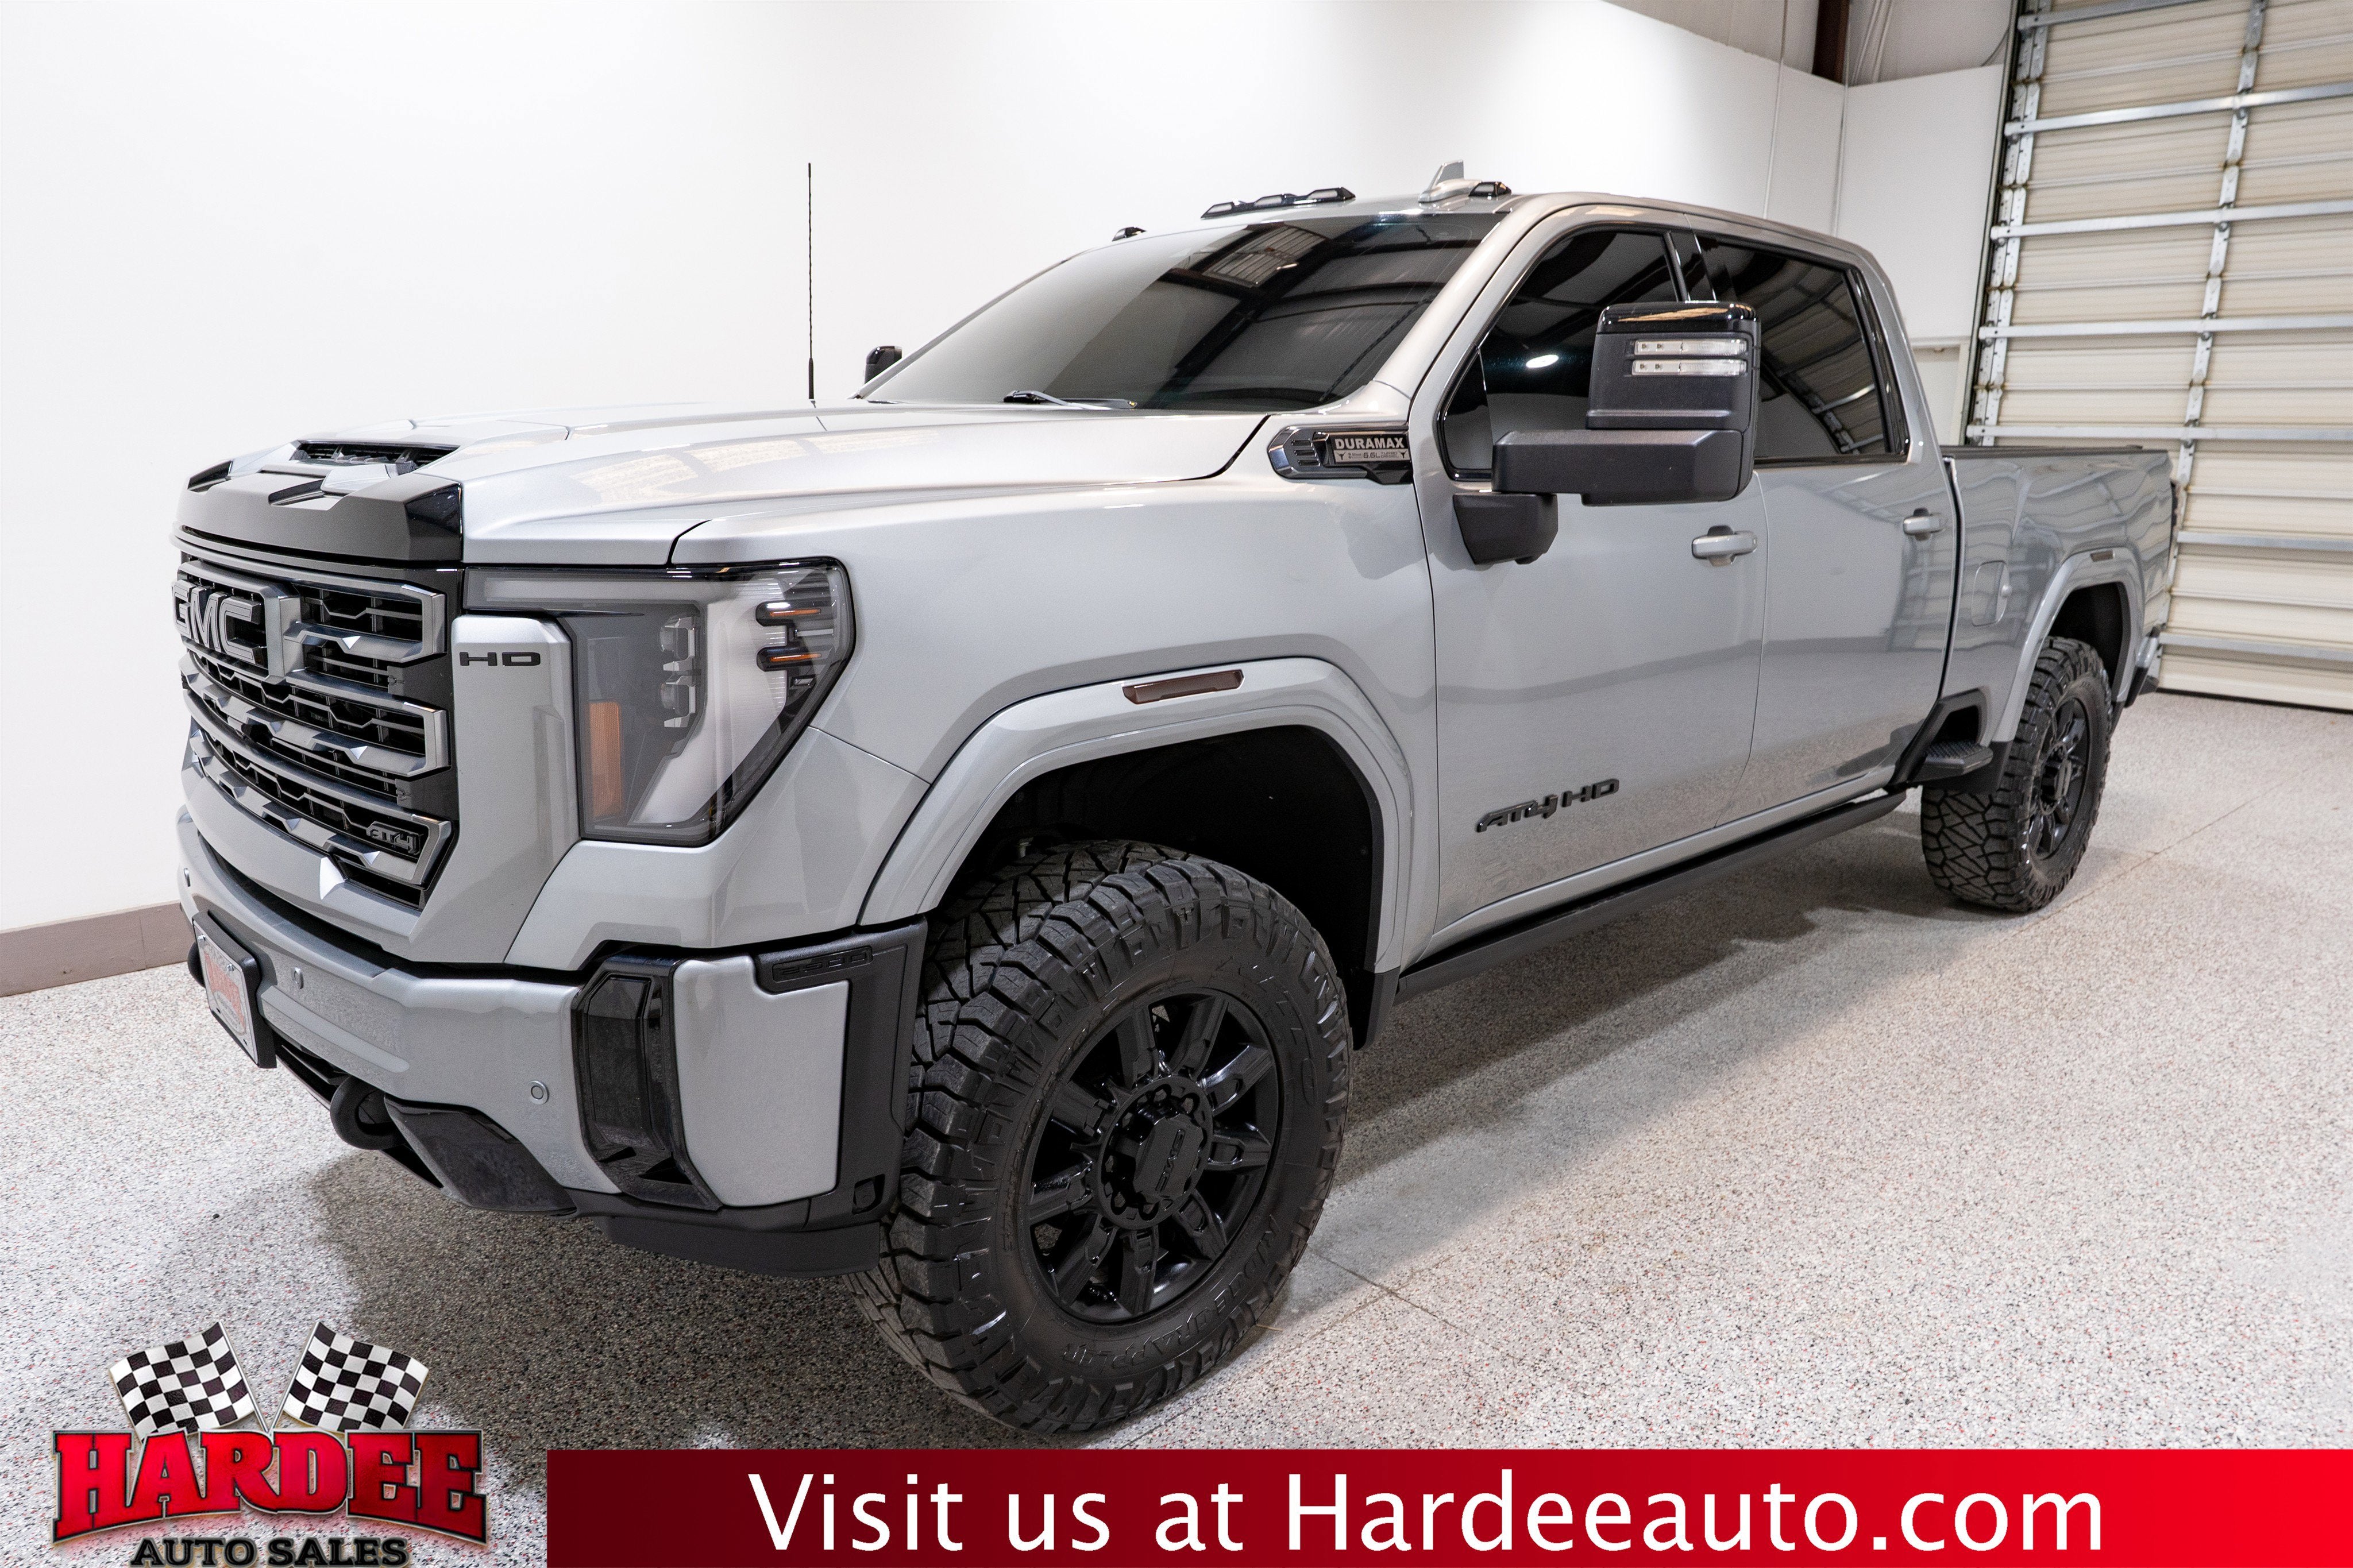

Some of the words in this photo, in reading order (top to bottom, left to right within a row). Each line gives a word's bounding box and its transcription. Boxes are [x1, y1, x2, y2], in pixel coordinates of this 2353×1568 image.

[1334, 438, 1405, 449] DURAMAX
[172, 580, 263, 665] GMC
[459, 651, 541, 666] HD
[1475, 794, 1559, 833] AT4
[1562, 778, 1620, 808] HD
[367, 822, 416, 853] AT4
